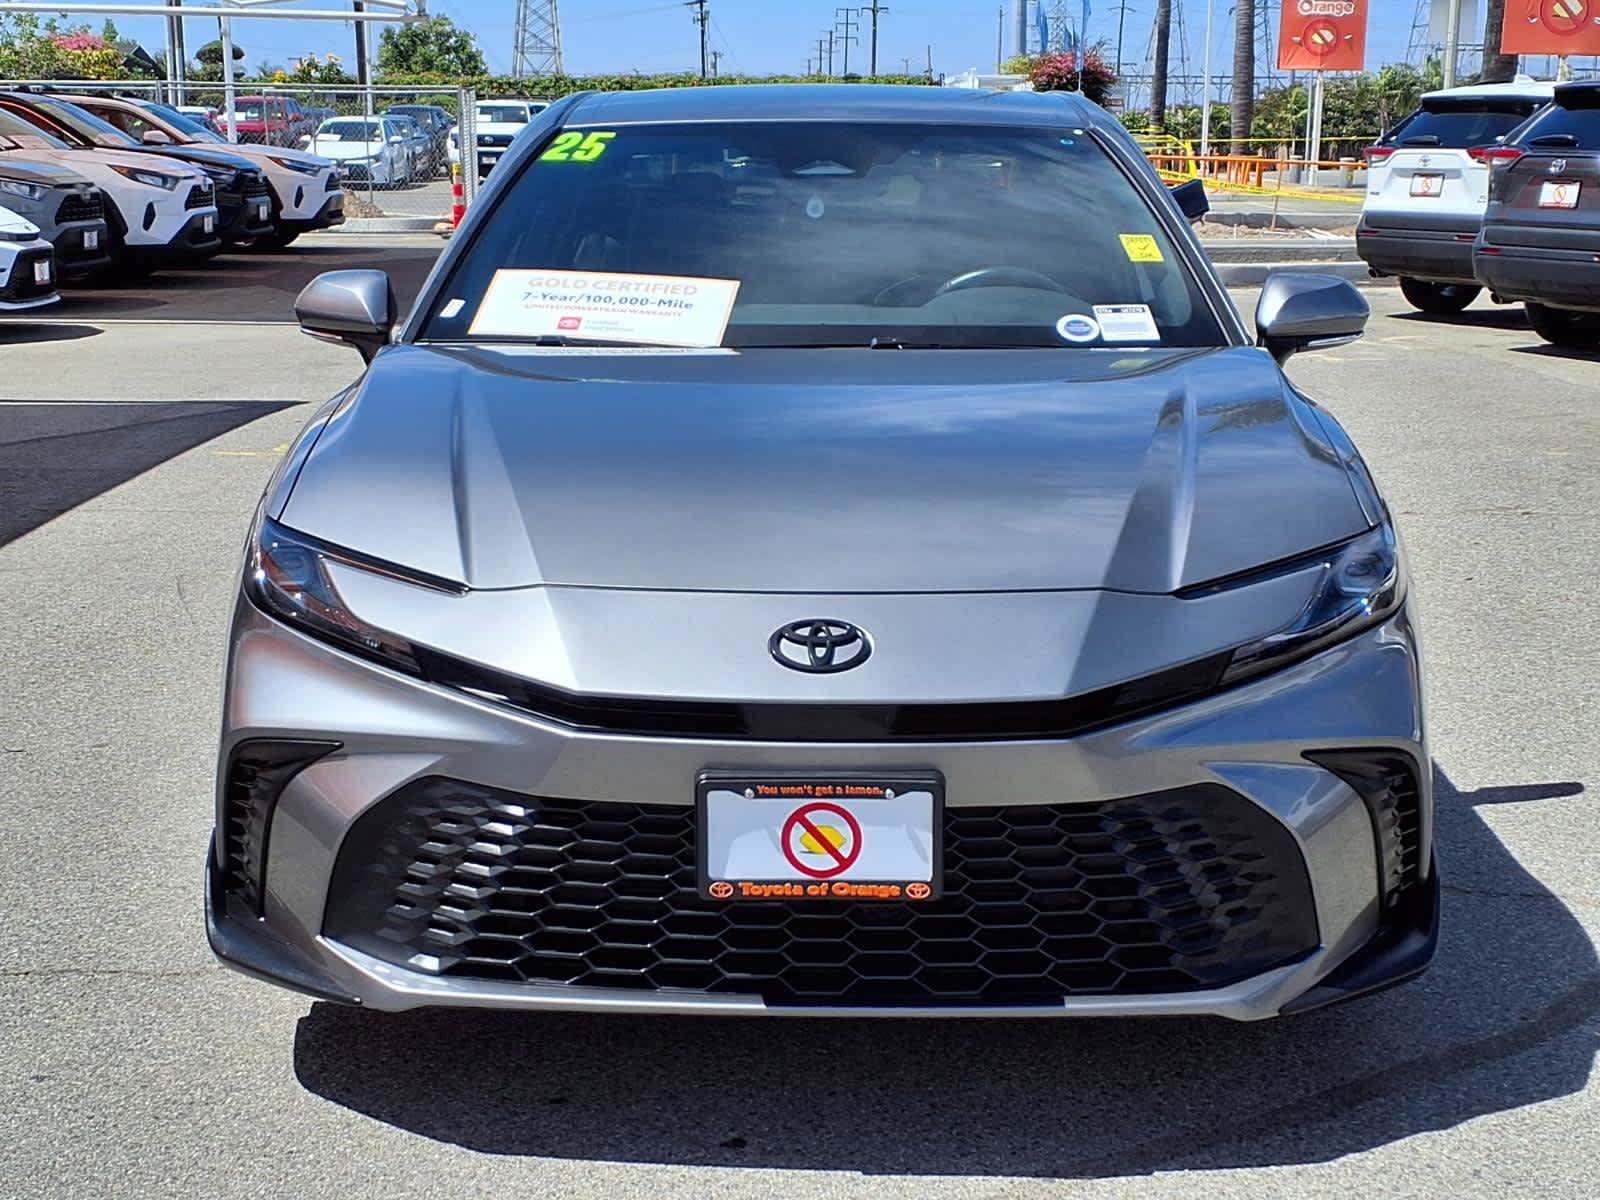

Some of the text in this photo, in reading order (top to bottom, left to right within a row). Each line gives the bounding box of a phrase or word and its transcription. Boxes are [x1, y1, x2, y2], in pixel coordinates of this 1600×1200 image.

[1297, 0, 1354, 16] Orange
[540, 131, 617, 161] 25
[528, 277, 698, 296] GOLD CERTIFIED
[521, 291, 695, 310] 7-Year/100,000-Mile
[756, 785, 778, 795] You
[780, 785, 813, 795] won't
[815, 785, 834, 797] get
[835, 786, 844, 795] a
[738, 882, 901, 898] Toyota of Orange
